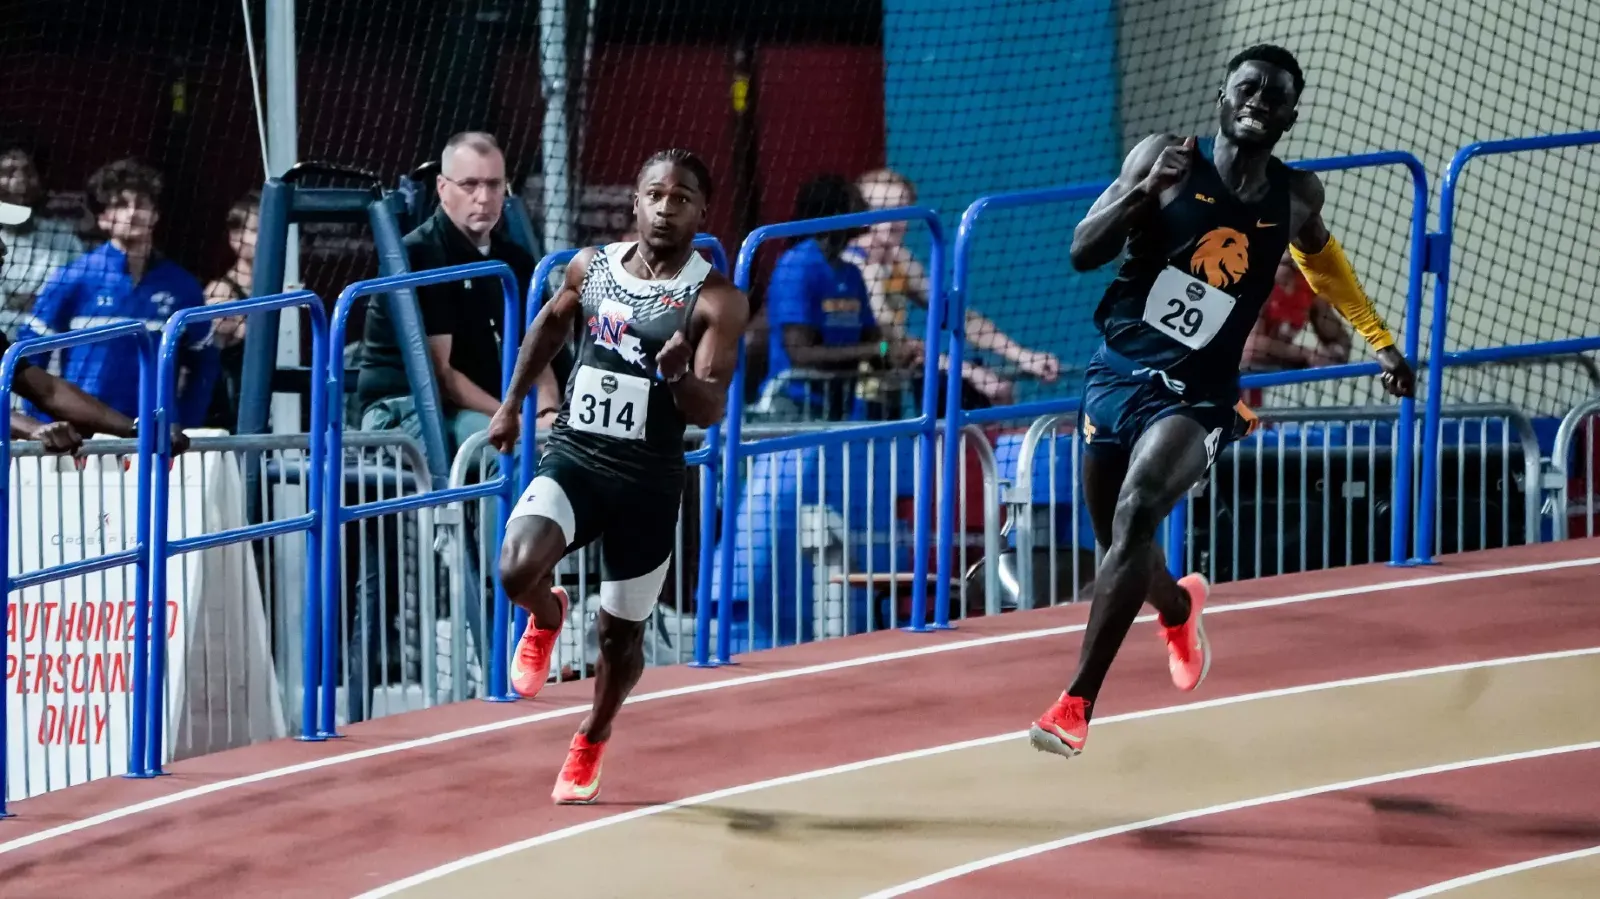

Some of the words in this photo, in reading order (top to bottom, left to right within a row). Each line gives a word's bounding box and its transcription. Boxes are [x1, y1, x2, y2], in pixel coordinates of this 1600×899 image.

[600, 316, 624, 347] N
[1160, 298, 1204, 338] 29
[578, 393, 635, 432] 314
[7, 653, 149, 694] PERSONN
[38, 704, 111, 746] ONLY
